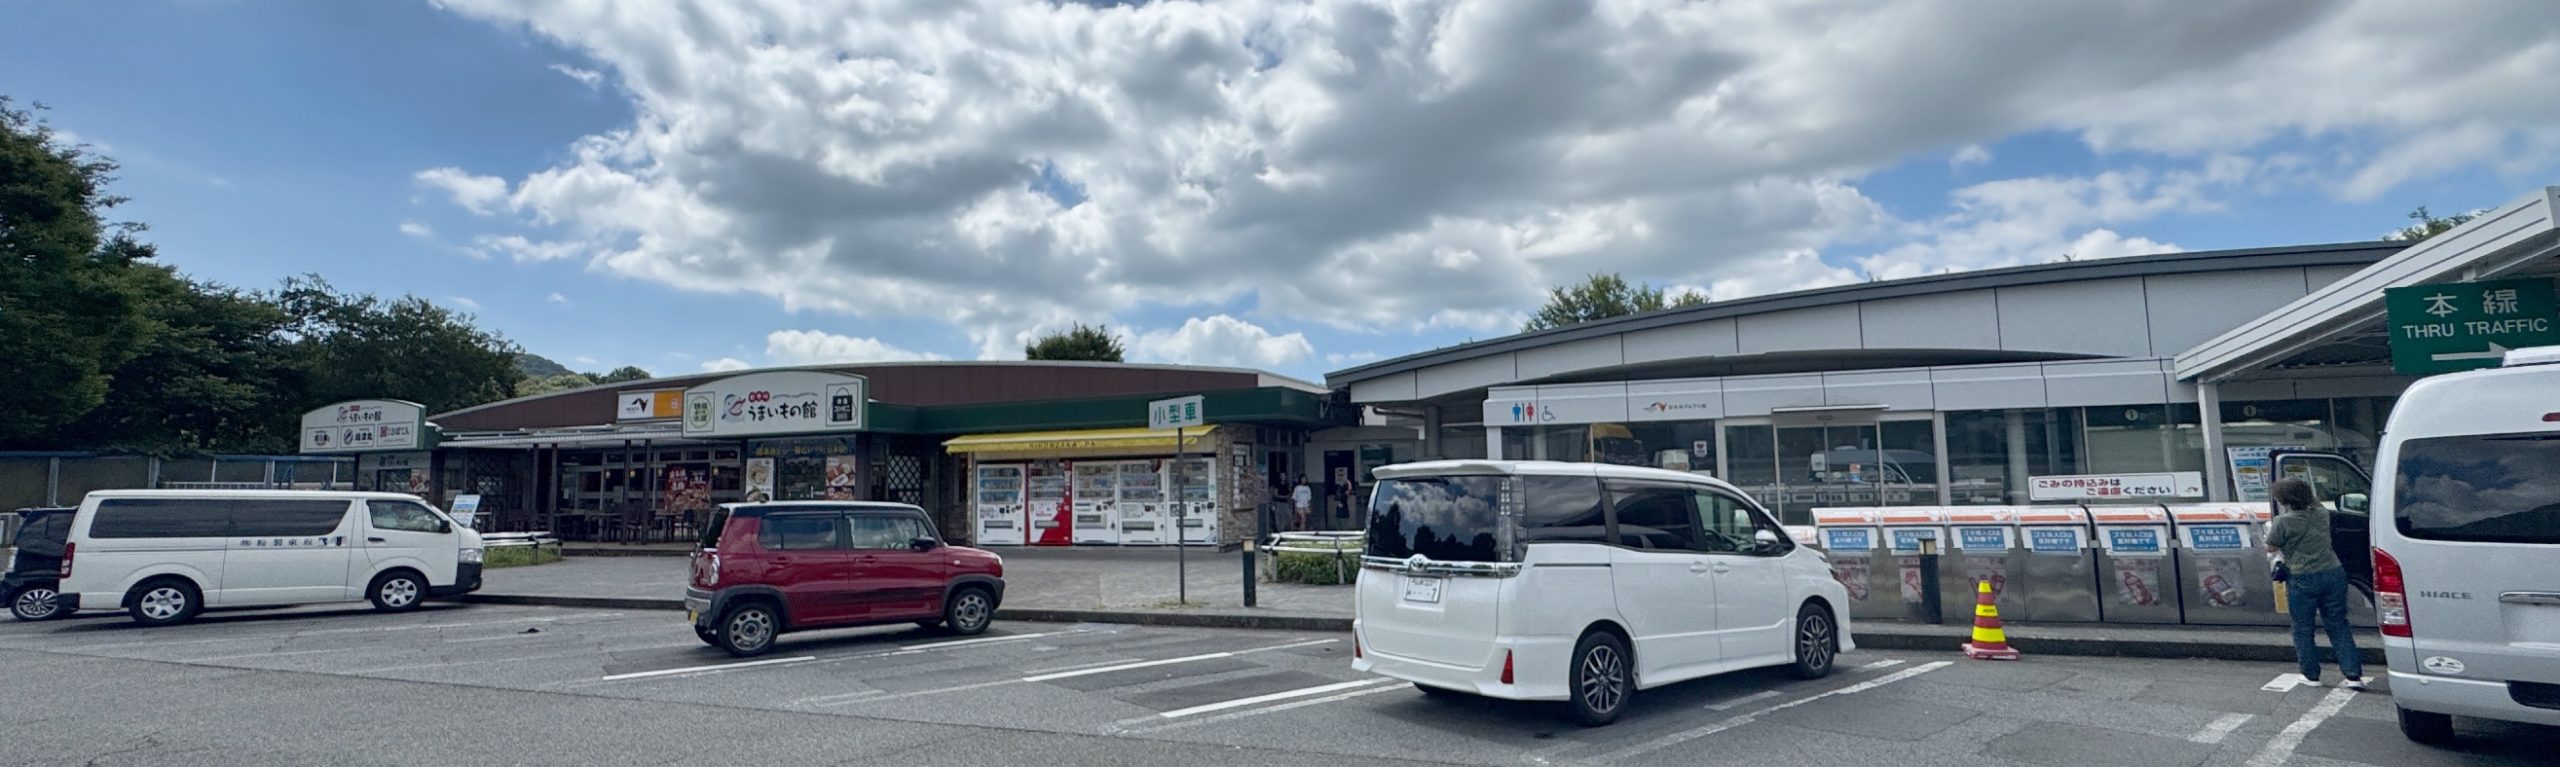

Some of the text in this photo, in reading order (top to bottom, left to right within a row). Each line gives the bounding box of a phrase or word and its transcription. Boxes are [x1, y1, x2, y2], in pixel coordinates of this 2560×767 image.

[2423, 289, 2518, 318] 本線
[2402, 318, 2549, 338] THRU TRAFFIC
[747, 401, 818, 421] うまいもの館
[1154, 401, 1197, 425] 小型車
[2038, 478, 2121, 489] ごみの持込みは
[2086, 486, 2171, 496] ご遠慮ください
[2420, 591, 2473, 600] HIACE
